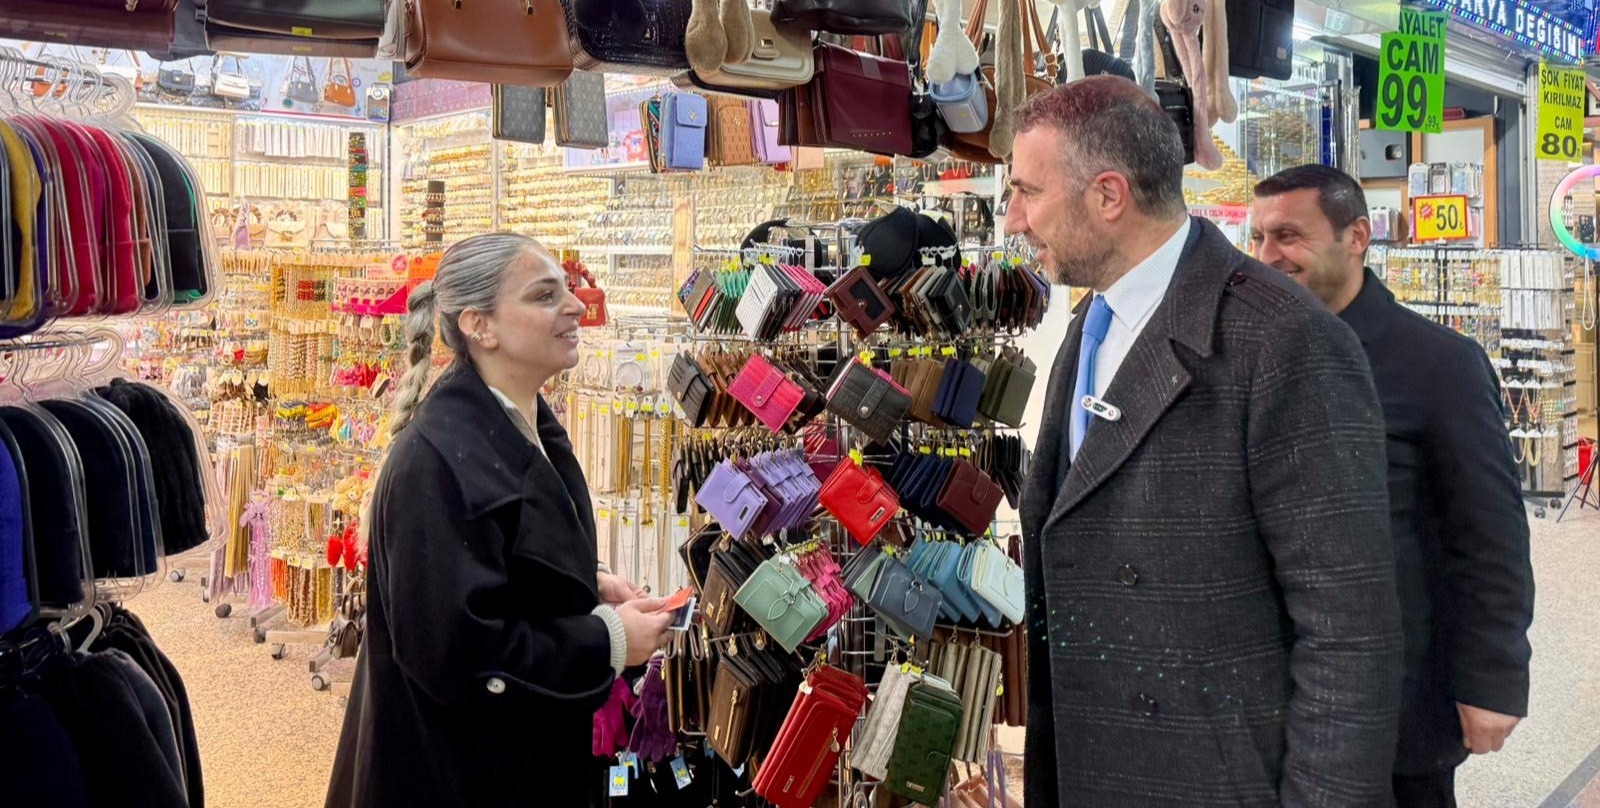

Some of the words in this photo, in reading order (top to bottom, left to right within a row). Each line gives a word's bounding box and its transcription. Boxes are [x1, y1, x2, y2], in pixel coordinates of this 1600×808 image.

[1387, 38, 1439, 75] CAM
[1541, 69, 1559, 89] ŞOK
[1563, 68, 1584, 92] FİYAT
[1381, 72, 1427, 128] 99
[1543, 91, 1582, 109] KIRILMAZ
[1554, 116, 1572, 131] CAM
[1541, 132, 1577, 158] 80
[1436, 204, 1458, 231] 50
